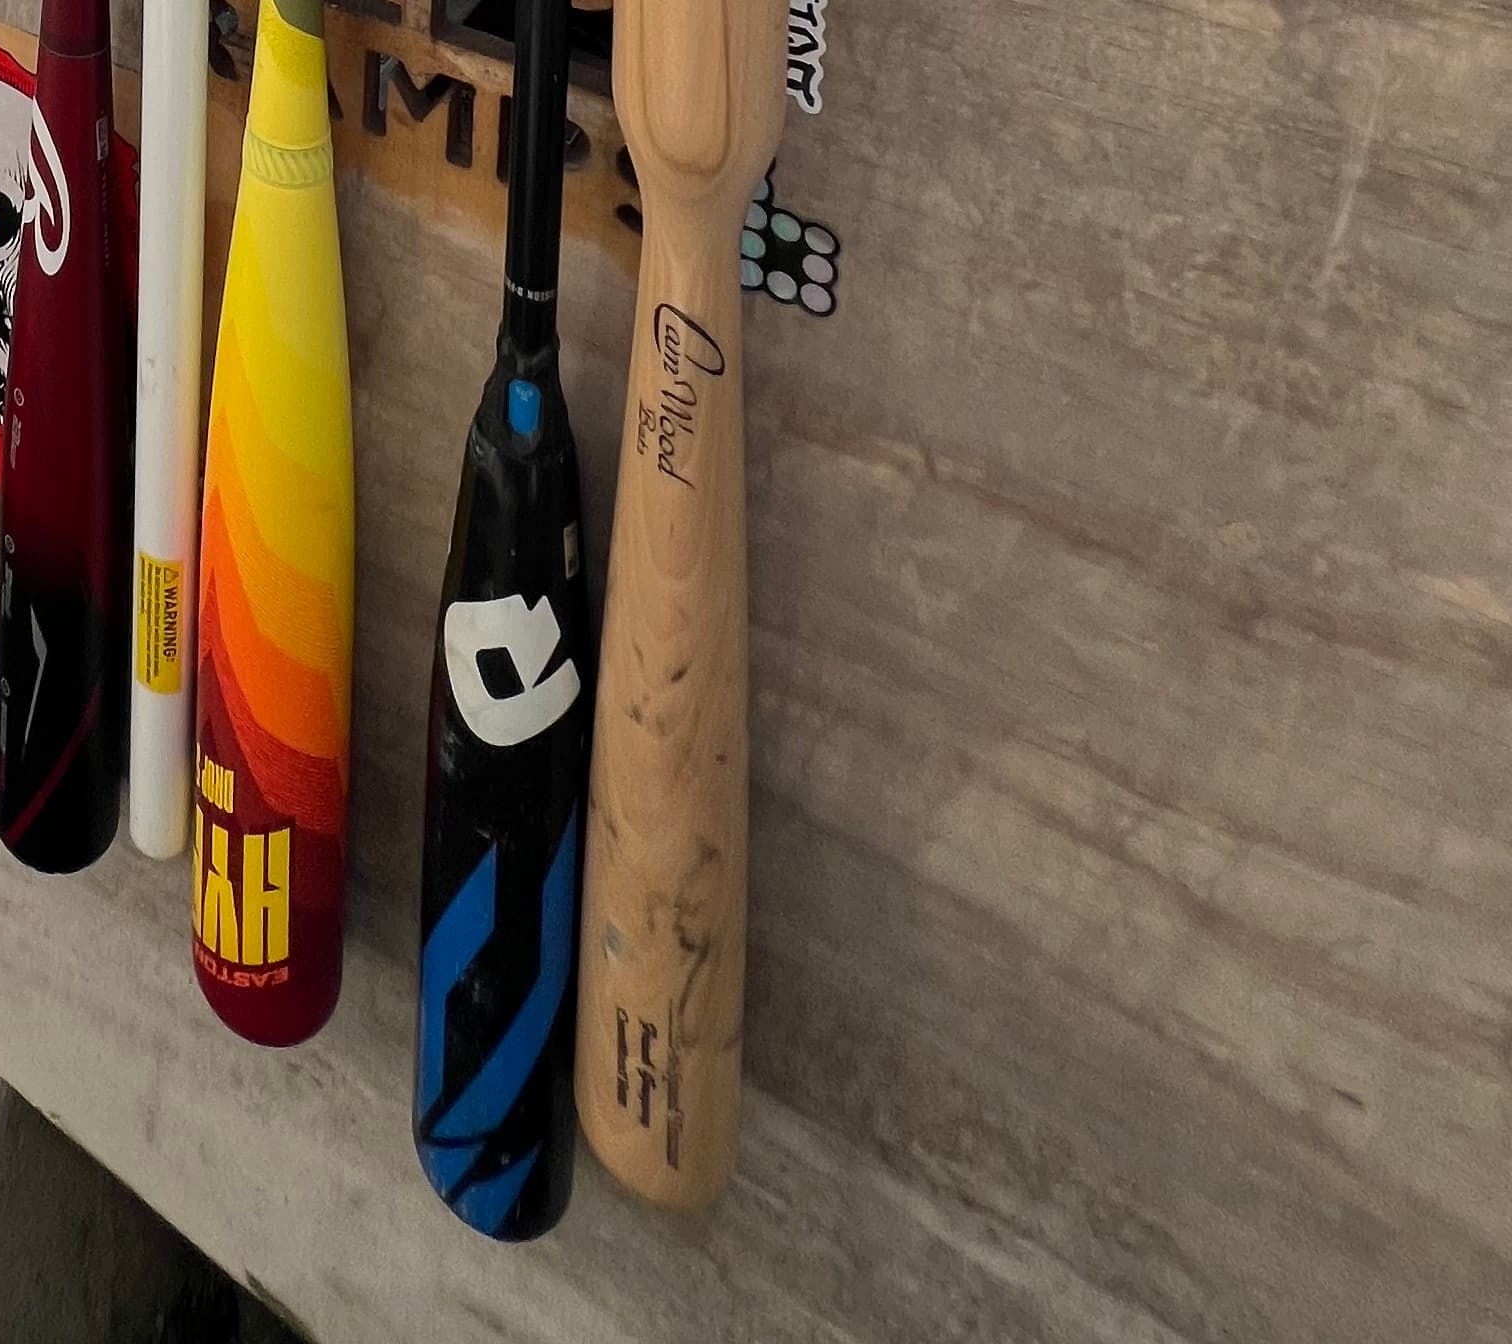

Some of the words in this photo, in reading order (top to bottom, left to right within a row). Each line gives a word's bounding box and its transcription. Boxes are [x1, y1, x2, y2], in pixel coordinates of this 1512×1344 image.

[654, 303, 726, 377] Cam
[657, 379, 698, 491] Wood
[161, 585, 178, 663] WARNING:
